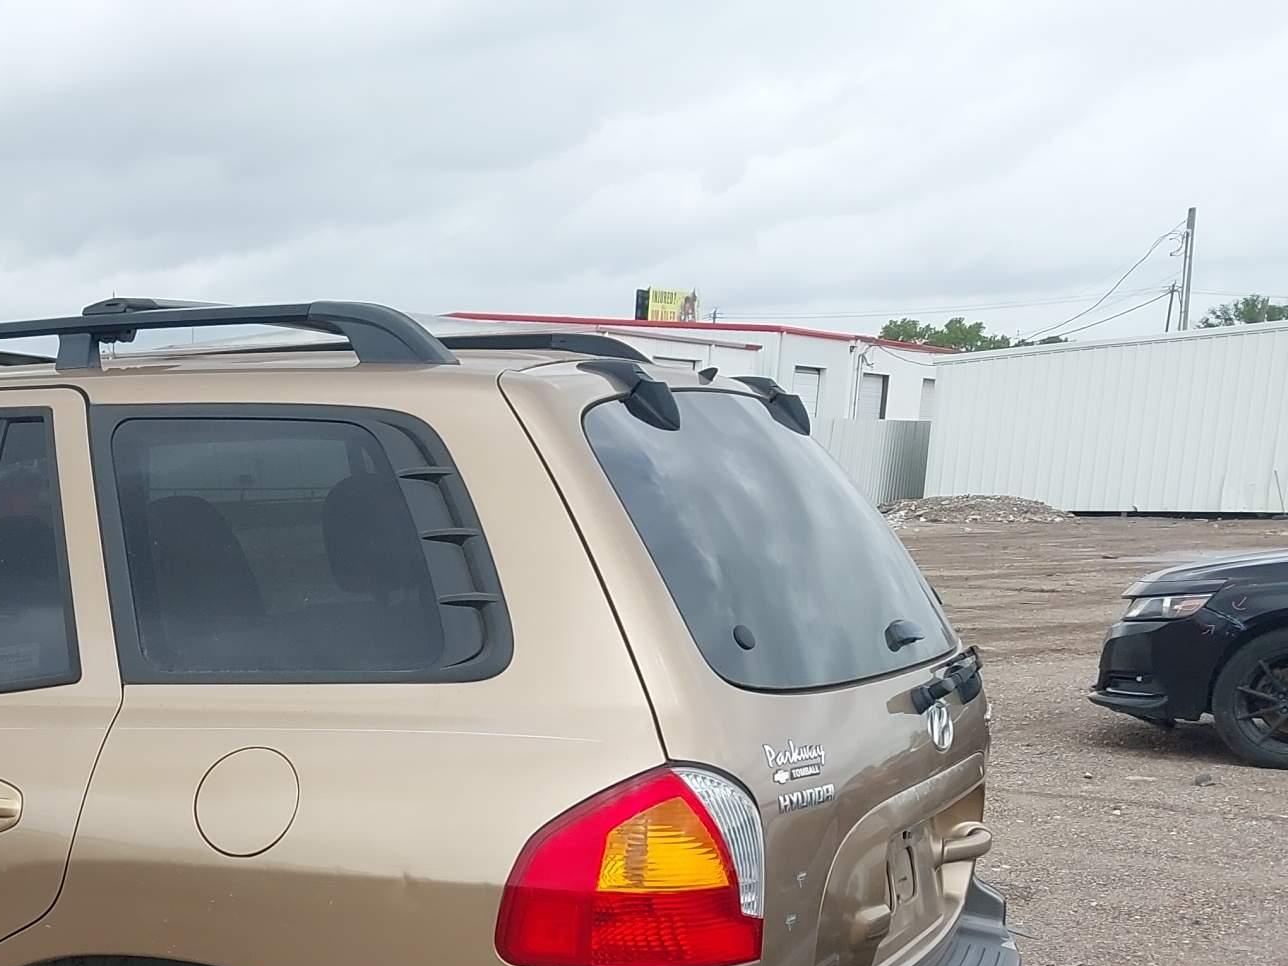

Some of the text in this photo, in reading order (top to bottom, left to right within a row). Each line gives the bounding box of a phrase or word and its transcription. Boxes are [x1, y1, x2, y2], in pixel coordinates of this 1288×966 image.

[652, 289, 677, 304] INJURED?
[762, 739, 825, 768] Parkway
[778, 783, 835, 814] HYUNDAI
